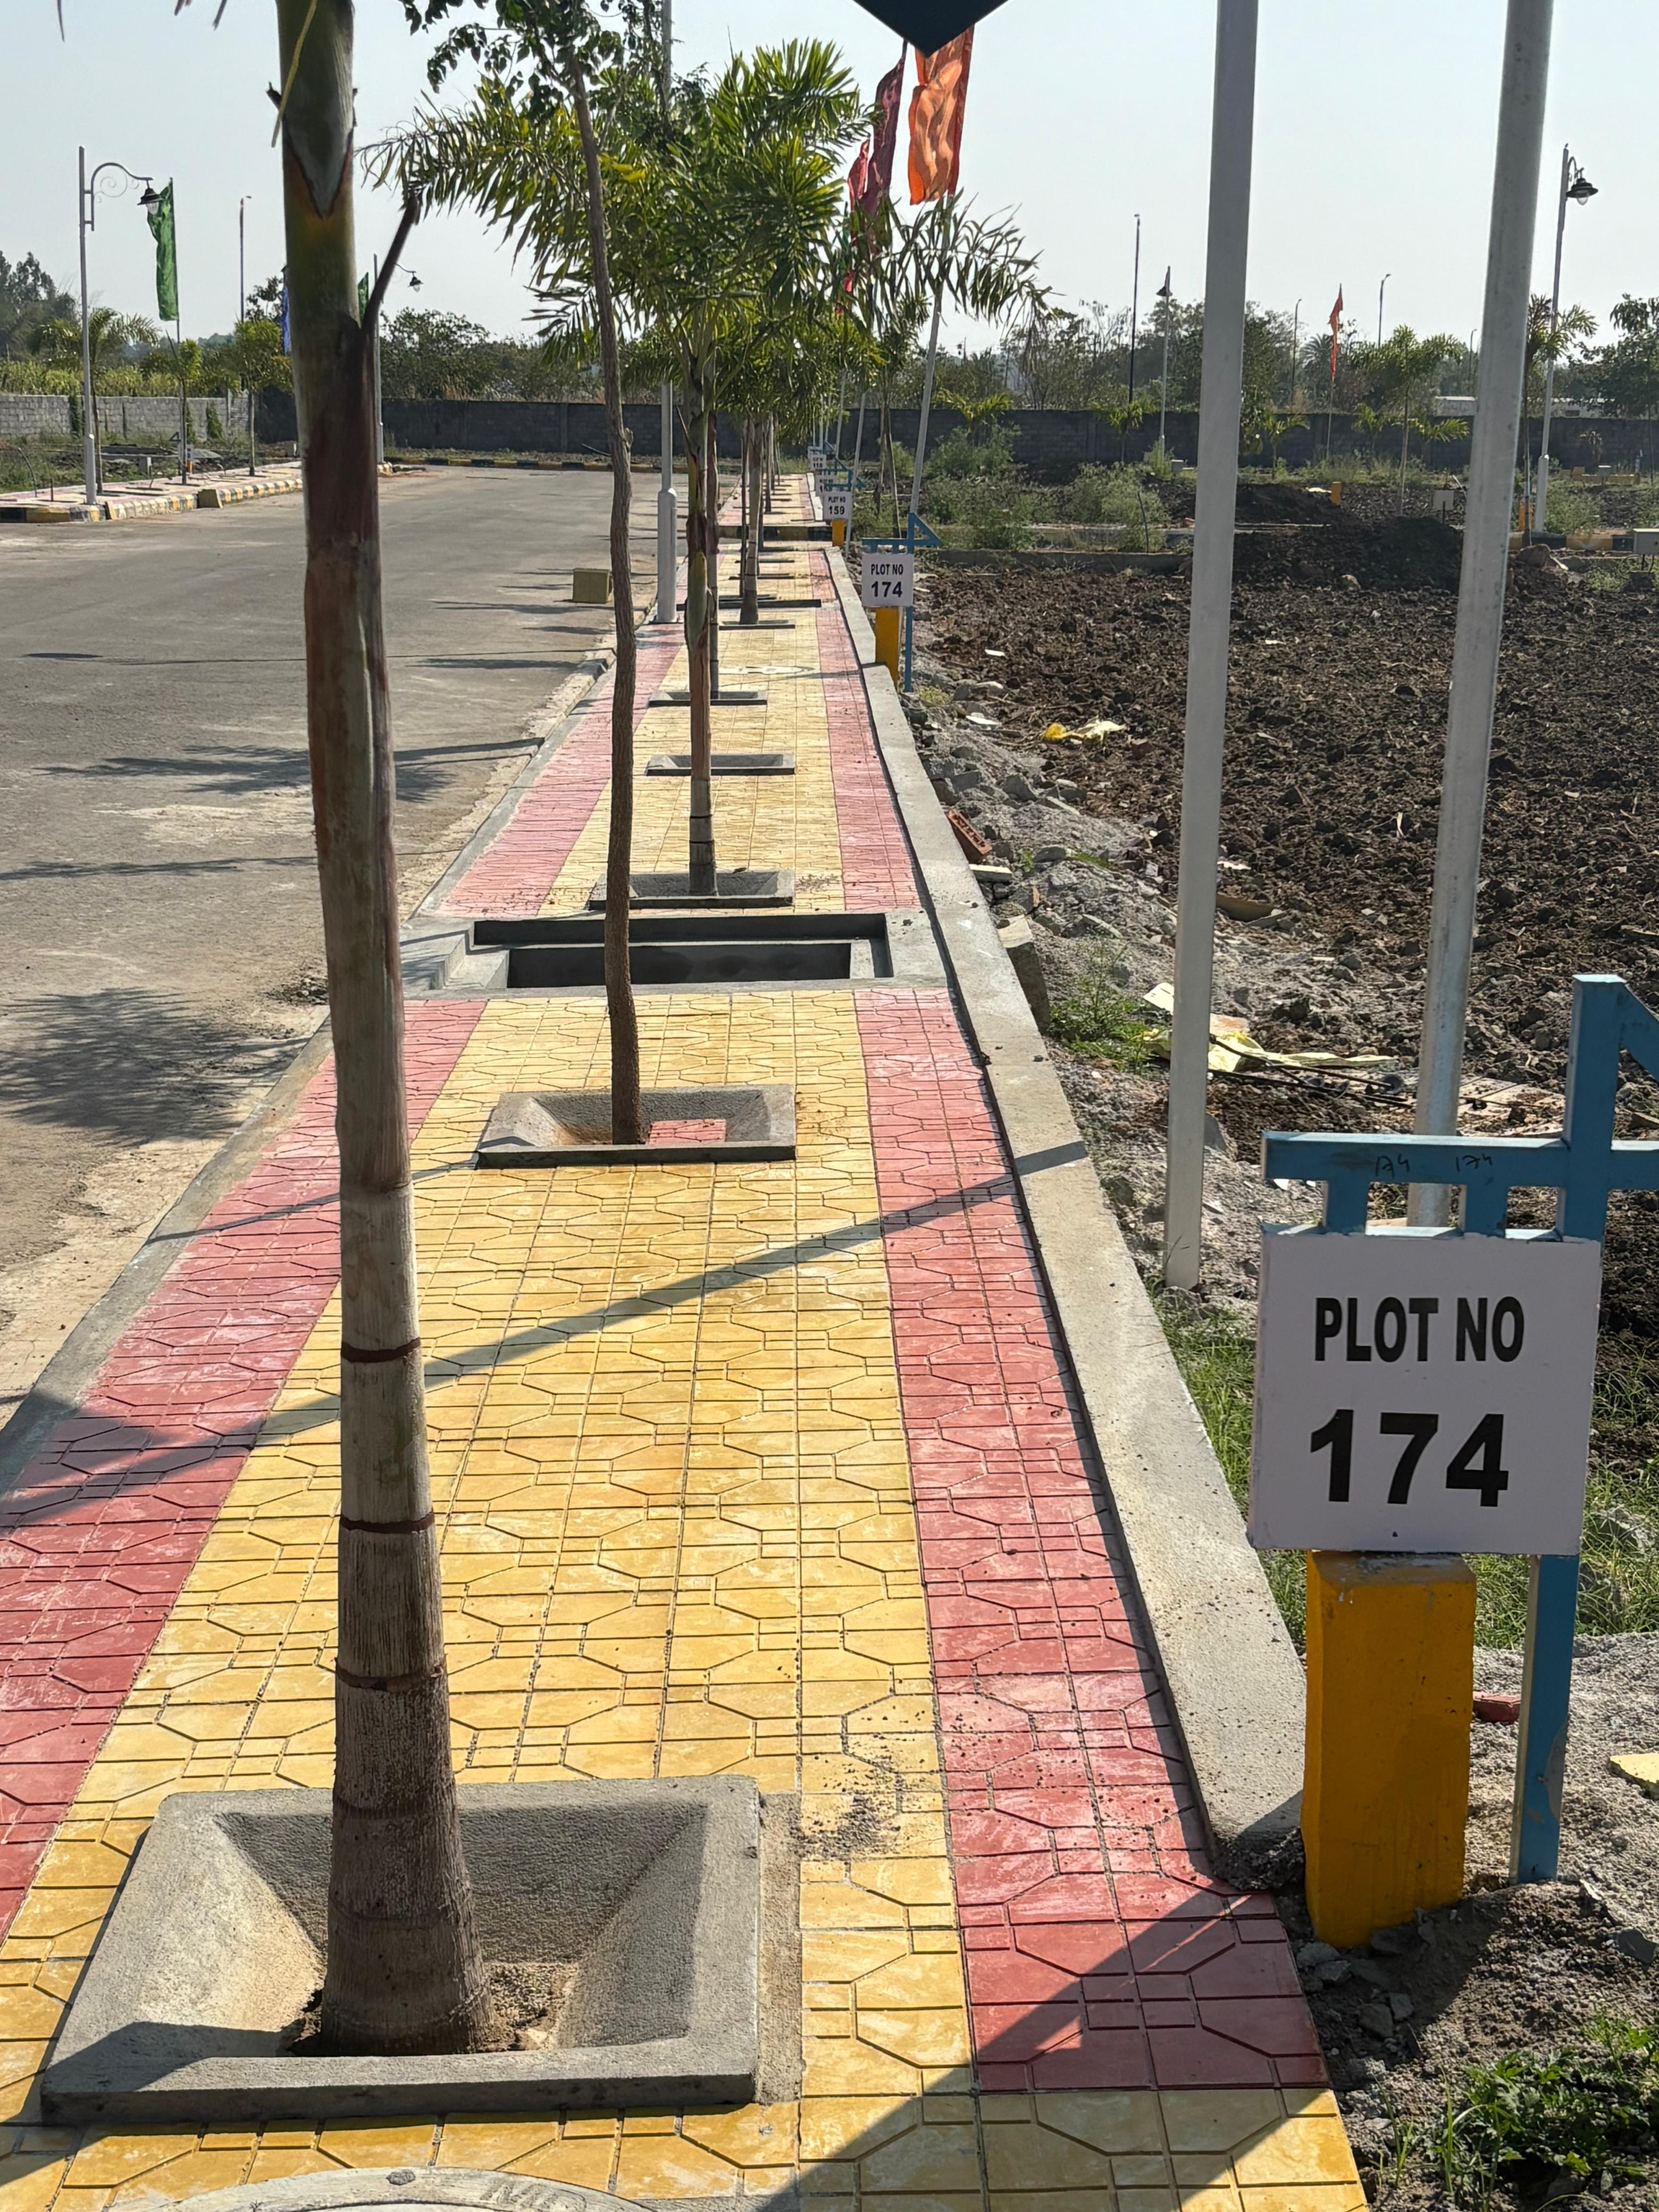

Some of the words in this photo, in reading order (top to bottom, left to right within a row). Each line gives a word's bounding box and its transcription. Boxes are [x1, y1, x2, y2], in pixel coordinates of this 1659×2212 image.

[829, 506, 845, 515] 159
[871, 564, 890, 575] PLOT
[892, 564, 903, 575] NO
[872, 581, 902, 598] 174
[1455, 1153, 1493, 1172] 174
[1314, 1296, 1439, 1362] PLOT
[1455, 1296, 1524, 1362] NO
[1310, 1409, 1509, 1508] 174
